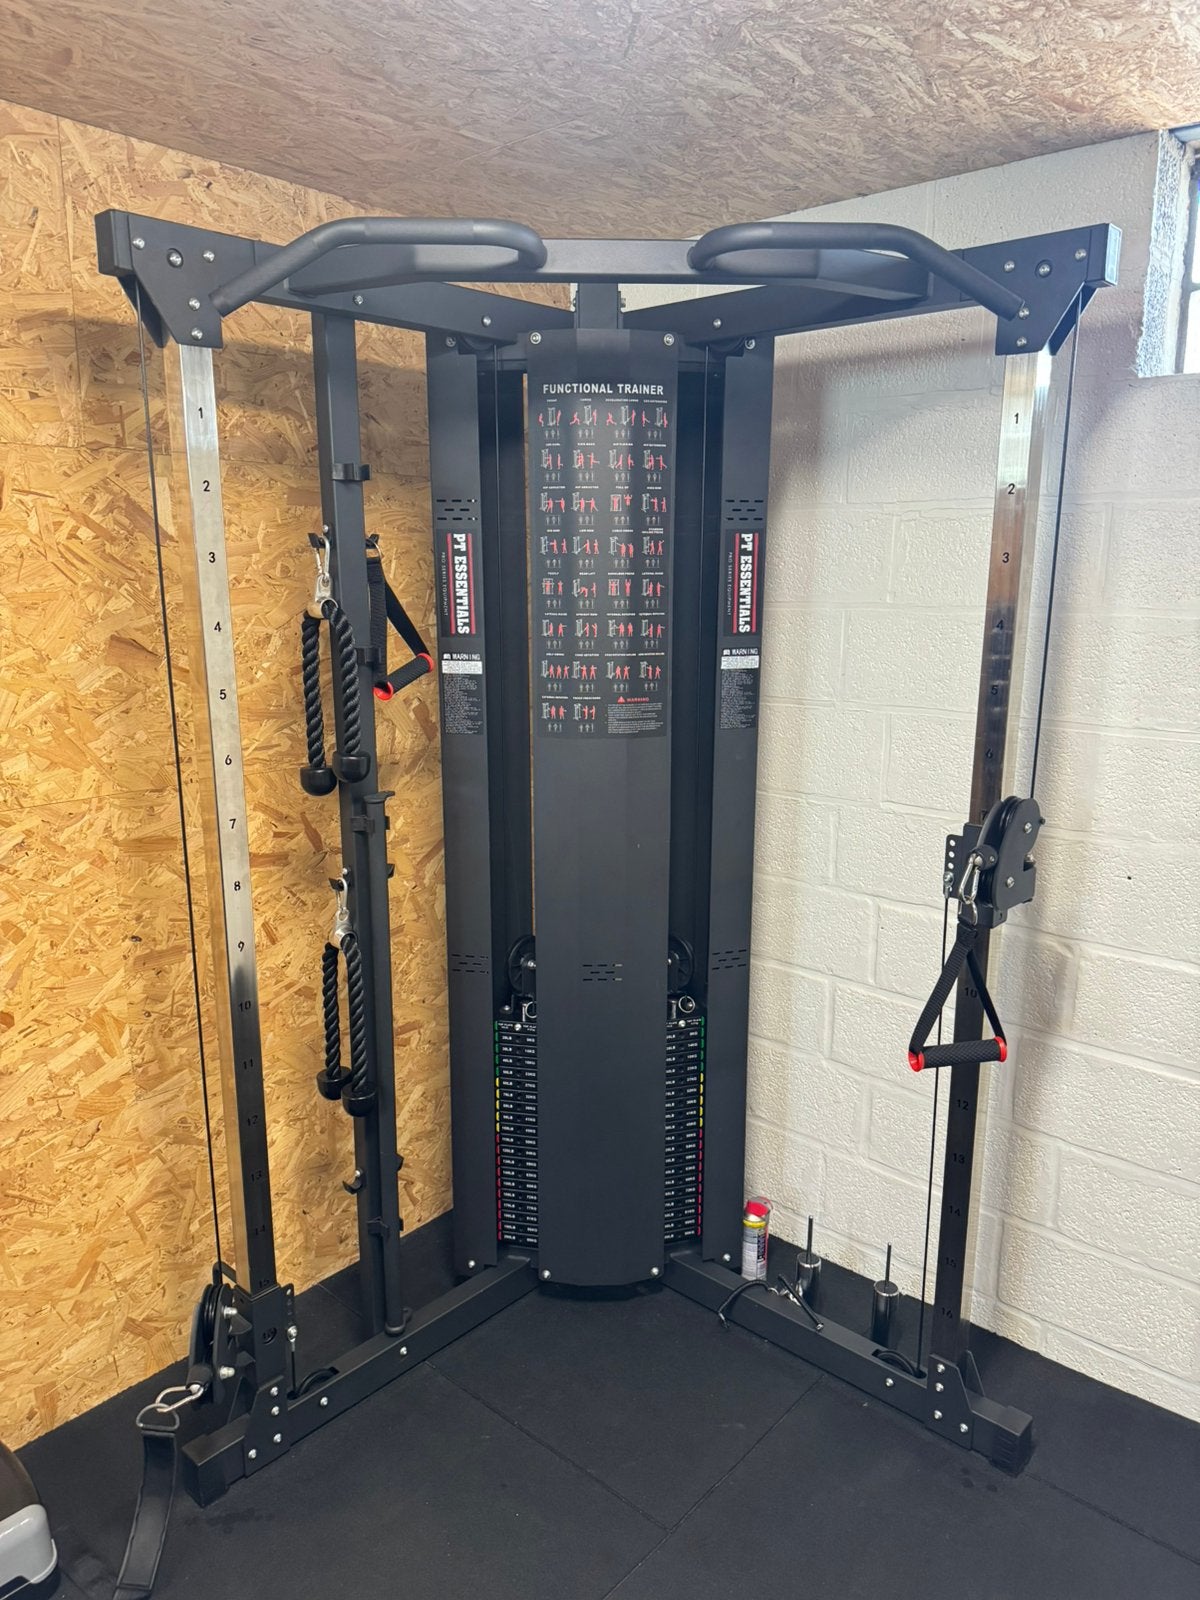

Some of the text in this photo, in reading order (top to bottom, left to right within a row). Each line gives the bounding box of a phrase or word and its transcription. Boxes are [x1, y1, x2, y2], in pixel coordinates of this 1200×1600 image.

[543, 383, 664, 395] FUNCTIONAL TRAINER
[198, 407, 203, 419] 1
[1014, 413, 1019, 424] 1
[202, 480, 211, 492] 2
[1008, 483, 1015, 495] 2
[208, 552, 216, 563] 3
[1002, 552, 1009, 563] 3
[453, 533, 470, 634] PT ESSENTIALS
[738, 533, 753, 633] PT ESSENTIALS
[214, 621, 222, 633] 4
[996, 620, 1004, 631] 4
[219, 689, 227, 700] 5
[991, 685, 998, 695] 5
[985, 748, 993, 759] 6
[225, 755, 232, 766] 6
[229, 819, 237, 829] 7
[233, 881, 241, 891] 8
[238, 941, 245, 952] 9
[238, 1001, 251, 1012] 10
[242, 1059, 254, 1069] 11
[957, 1099, 969, 1111] 12
[246, 1115, 258, 1126] 12
[953, 1153, 965, 1164] 13
[251, 1171, 262, 1182] 13
[949, 1206, 961, 1217] 14
[254, 1225, 265, 1235] 14
[945, 1257, 957, 1268] 15
[941, 1308, 953, 1319] 16
